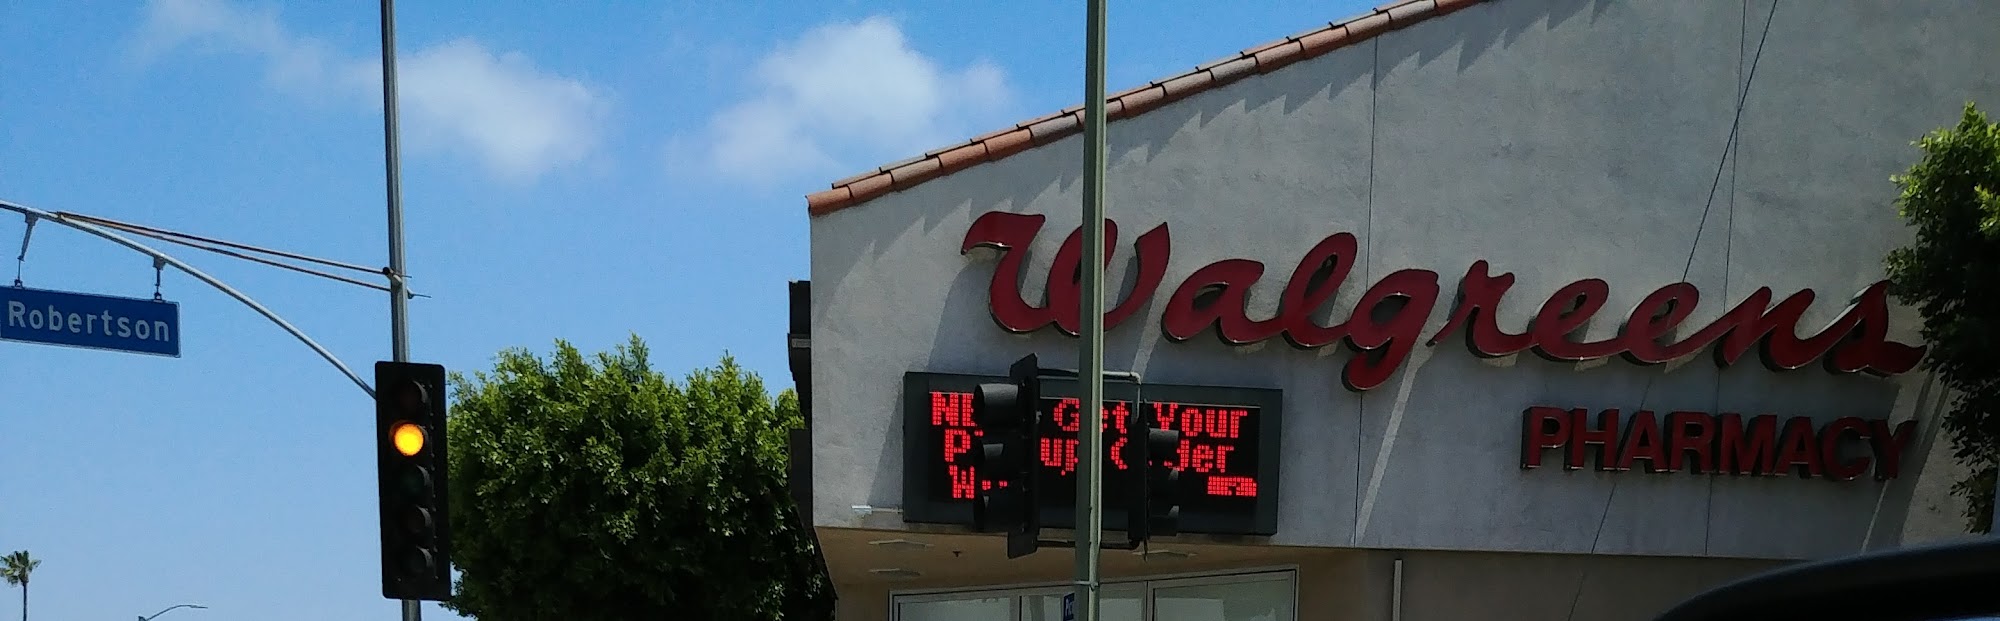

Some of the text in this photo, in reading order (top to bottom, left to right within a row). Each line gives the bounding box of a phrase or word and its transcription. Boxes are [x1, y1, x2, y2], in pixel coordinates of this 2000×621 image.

[8, 300, 169, 341] Robertson
[961, 210, 1925, 391] Walgreens
[1154, 402, 1247, 438] Your
[1520, 406, 1917, 482] PHARMACY
